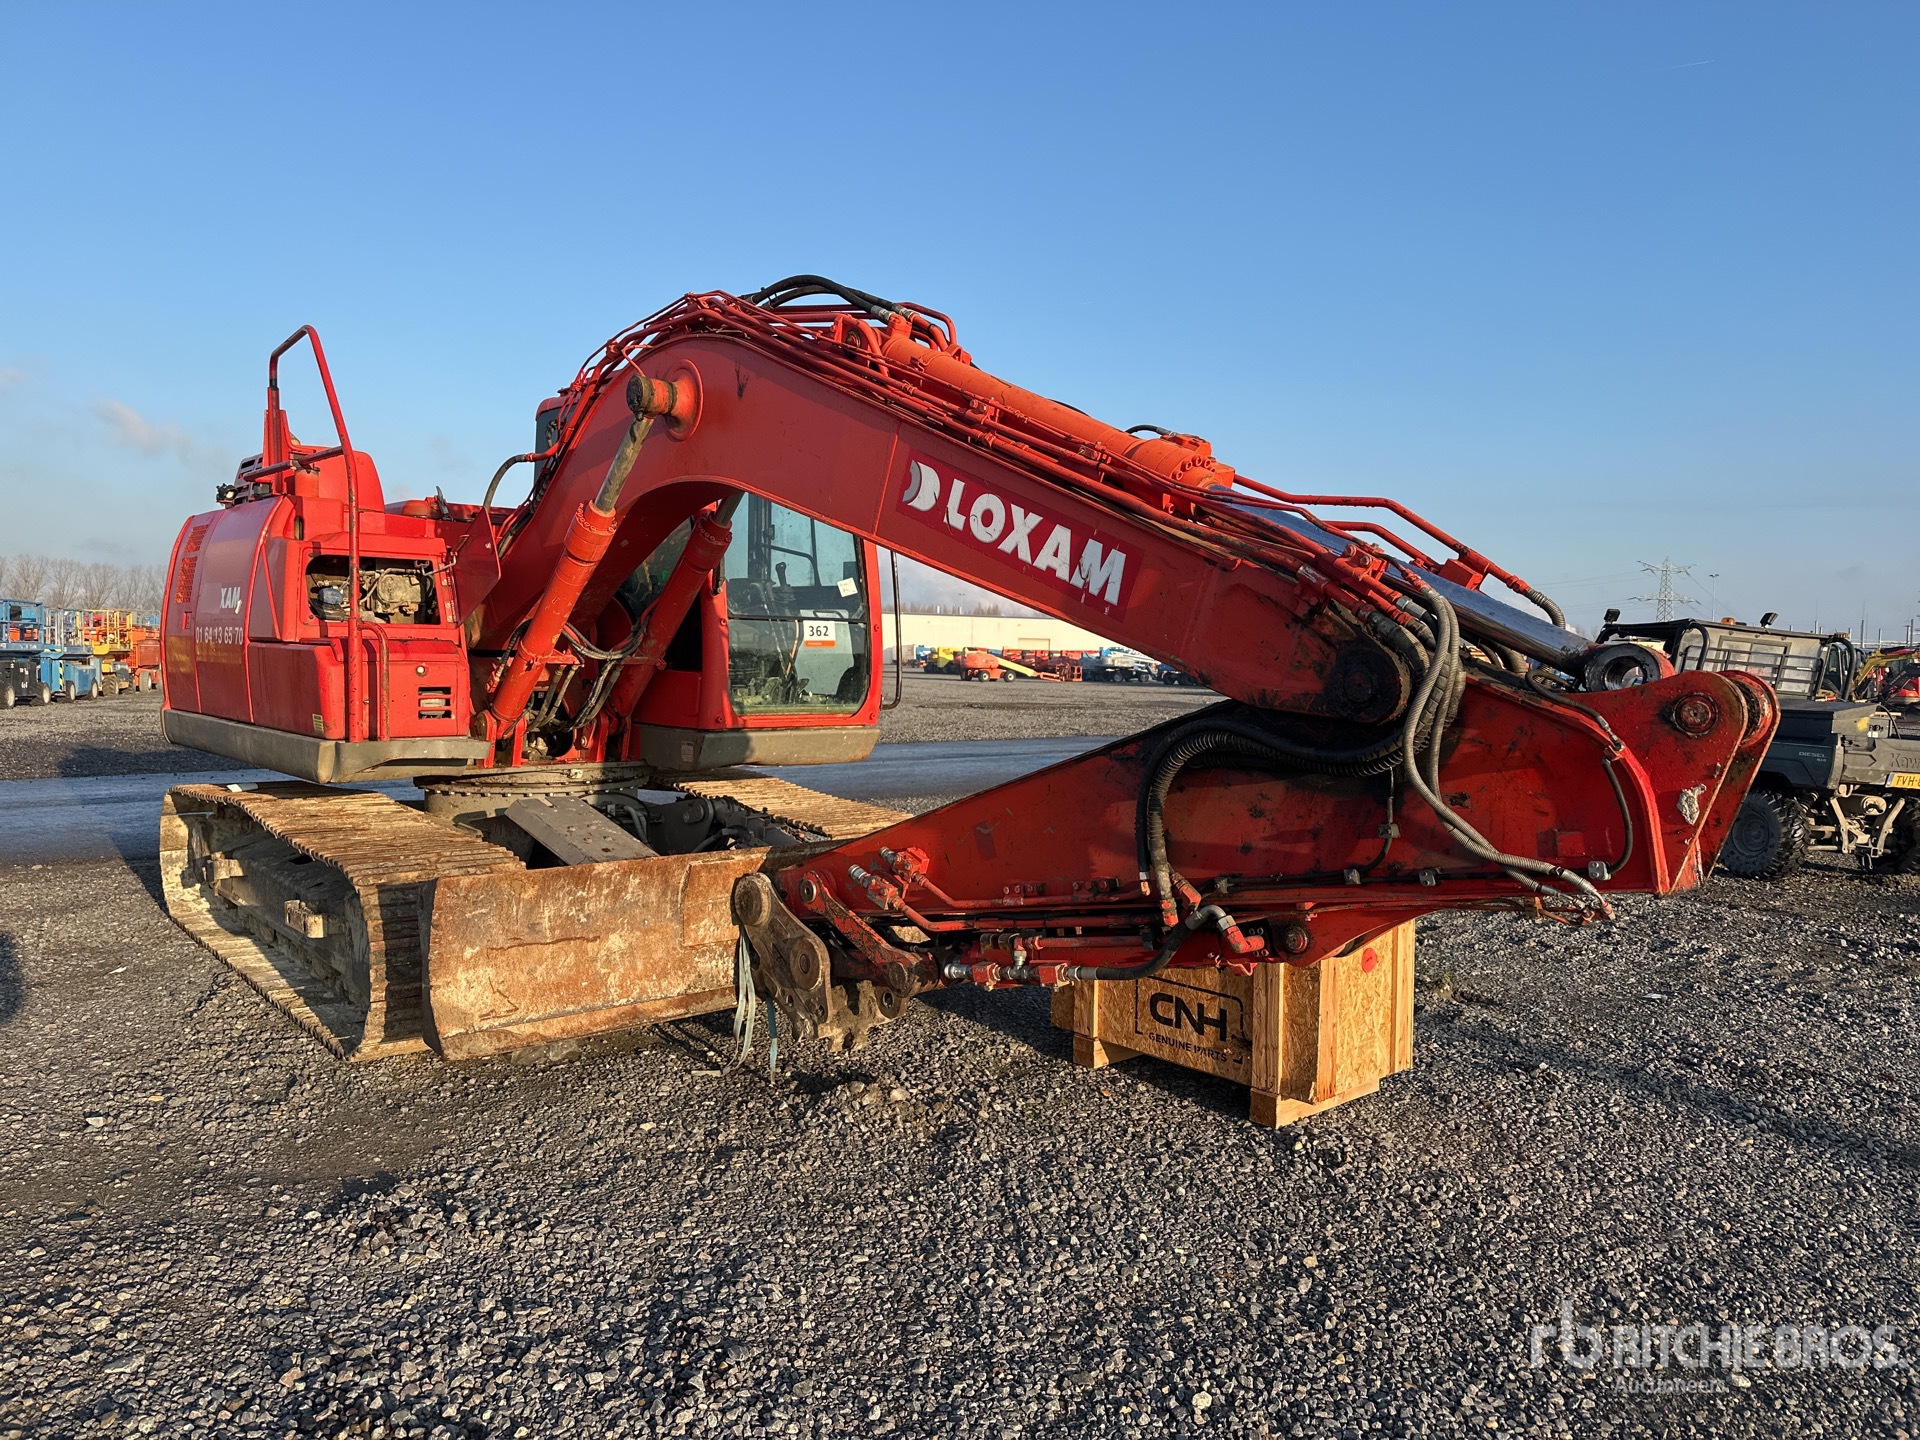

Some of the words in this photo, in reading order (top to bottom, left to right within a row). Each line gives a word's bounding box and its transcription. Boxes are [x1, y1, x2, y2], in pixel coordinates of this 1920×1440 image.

[943, 478, 1127, 606] LOXAM
[195, 626, 203, 643] 01
[224, 626, 233, 645] 65
[234, 627, 244, 646] 70
[808, 625, 829, 636] 362
[1150, 992, 1228, 1042] CNH
[1148, 1032, 1192, 1052] GENUINE
[1194, 1044, 1227, 1062] PARTS
